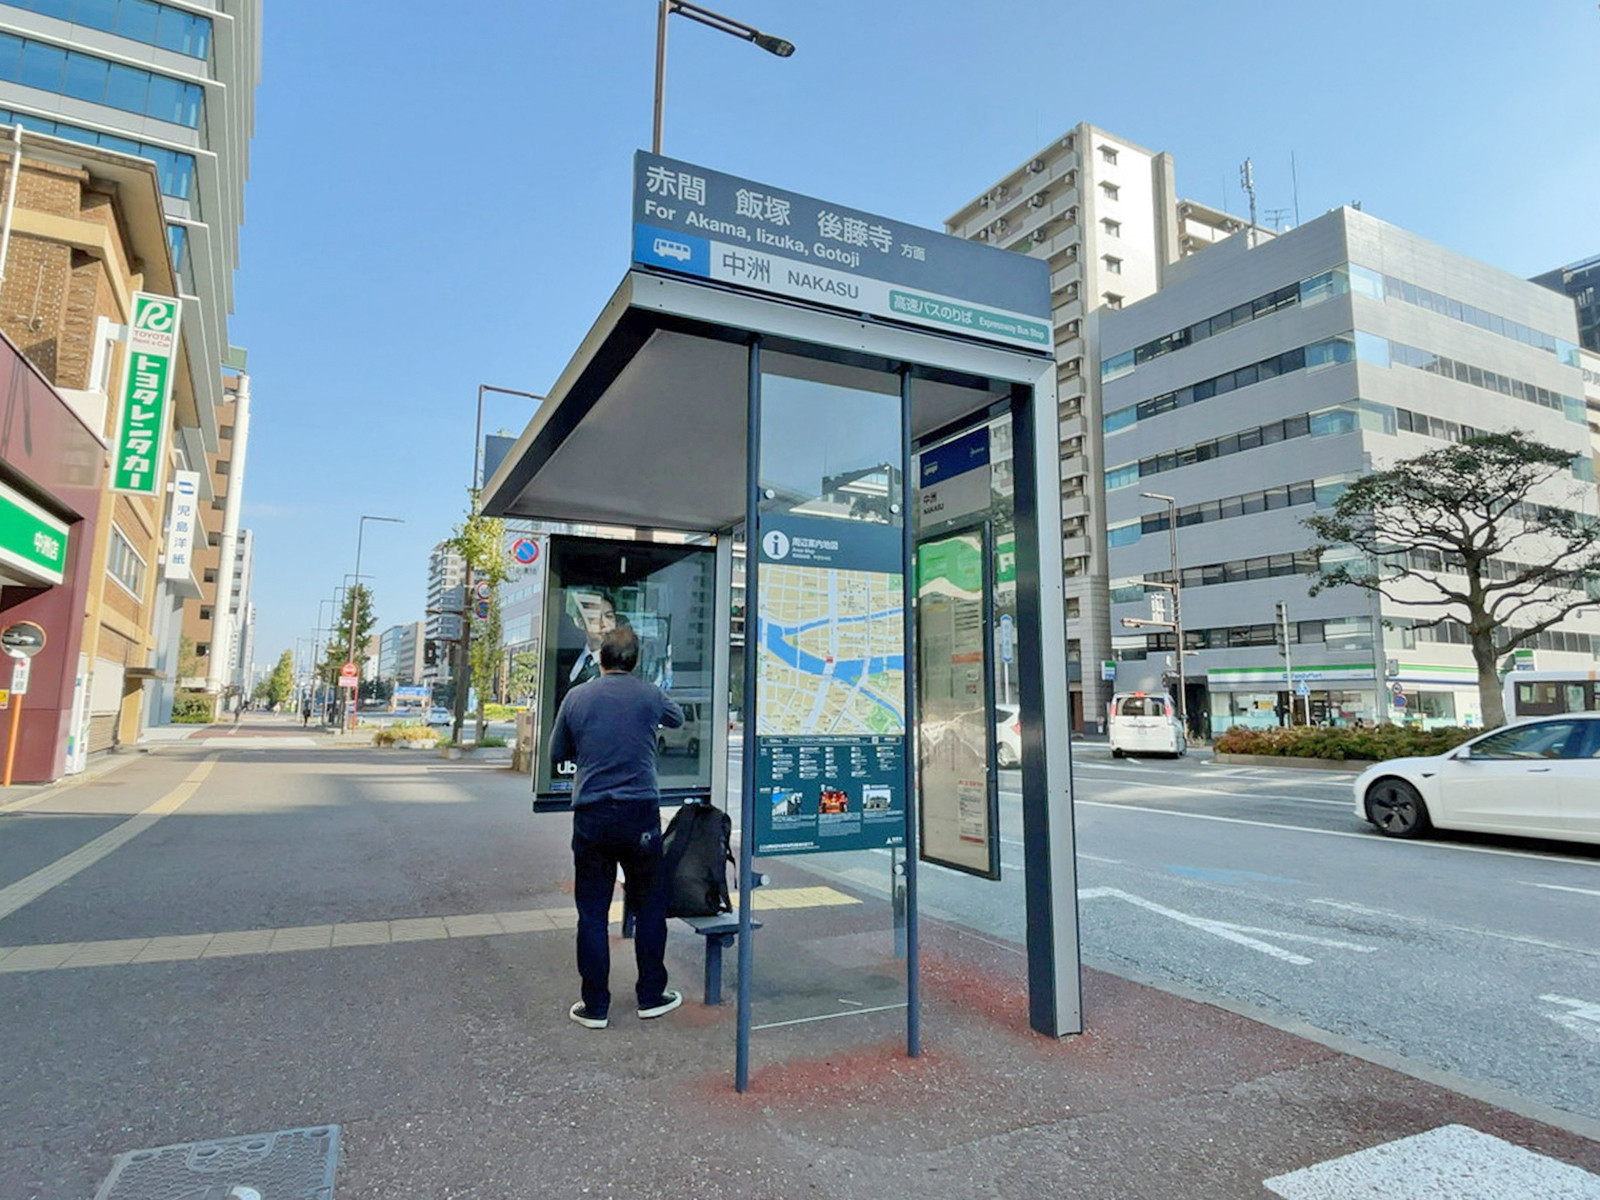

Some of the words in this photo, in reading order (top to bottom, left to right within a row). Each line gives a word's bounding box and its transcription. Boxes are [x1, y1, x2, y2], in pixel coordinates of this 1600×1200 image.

[645, 200, 676, 221] For
[686, 211, 752, 242] Akama,
[813, 242, 860, 268] Gotoji
[646, 166, 706, 206] 赤間
[735, 188, 790, 226] 飯塚
[817, 210, 893, 253] 後藤寺
[901, 243, 926, 262] 方面
[722, 251, 771, 284] 中洲
[788, 270, 859, 299] NAKASU
[133, 330, 171, 341] TOYOTA
[894, 294, 973, 324] 高速バスのりば
[1017, 325, 1029, 336] Bus
[1030, 328, 1045, 340] Stop
[122, 354, 161, 489] トヨタレンタカー
[172, 504, 190, 565] 児島洋紙
